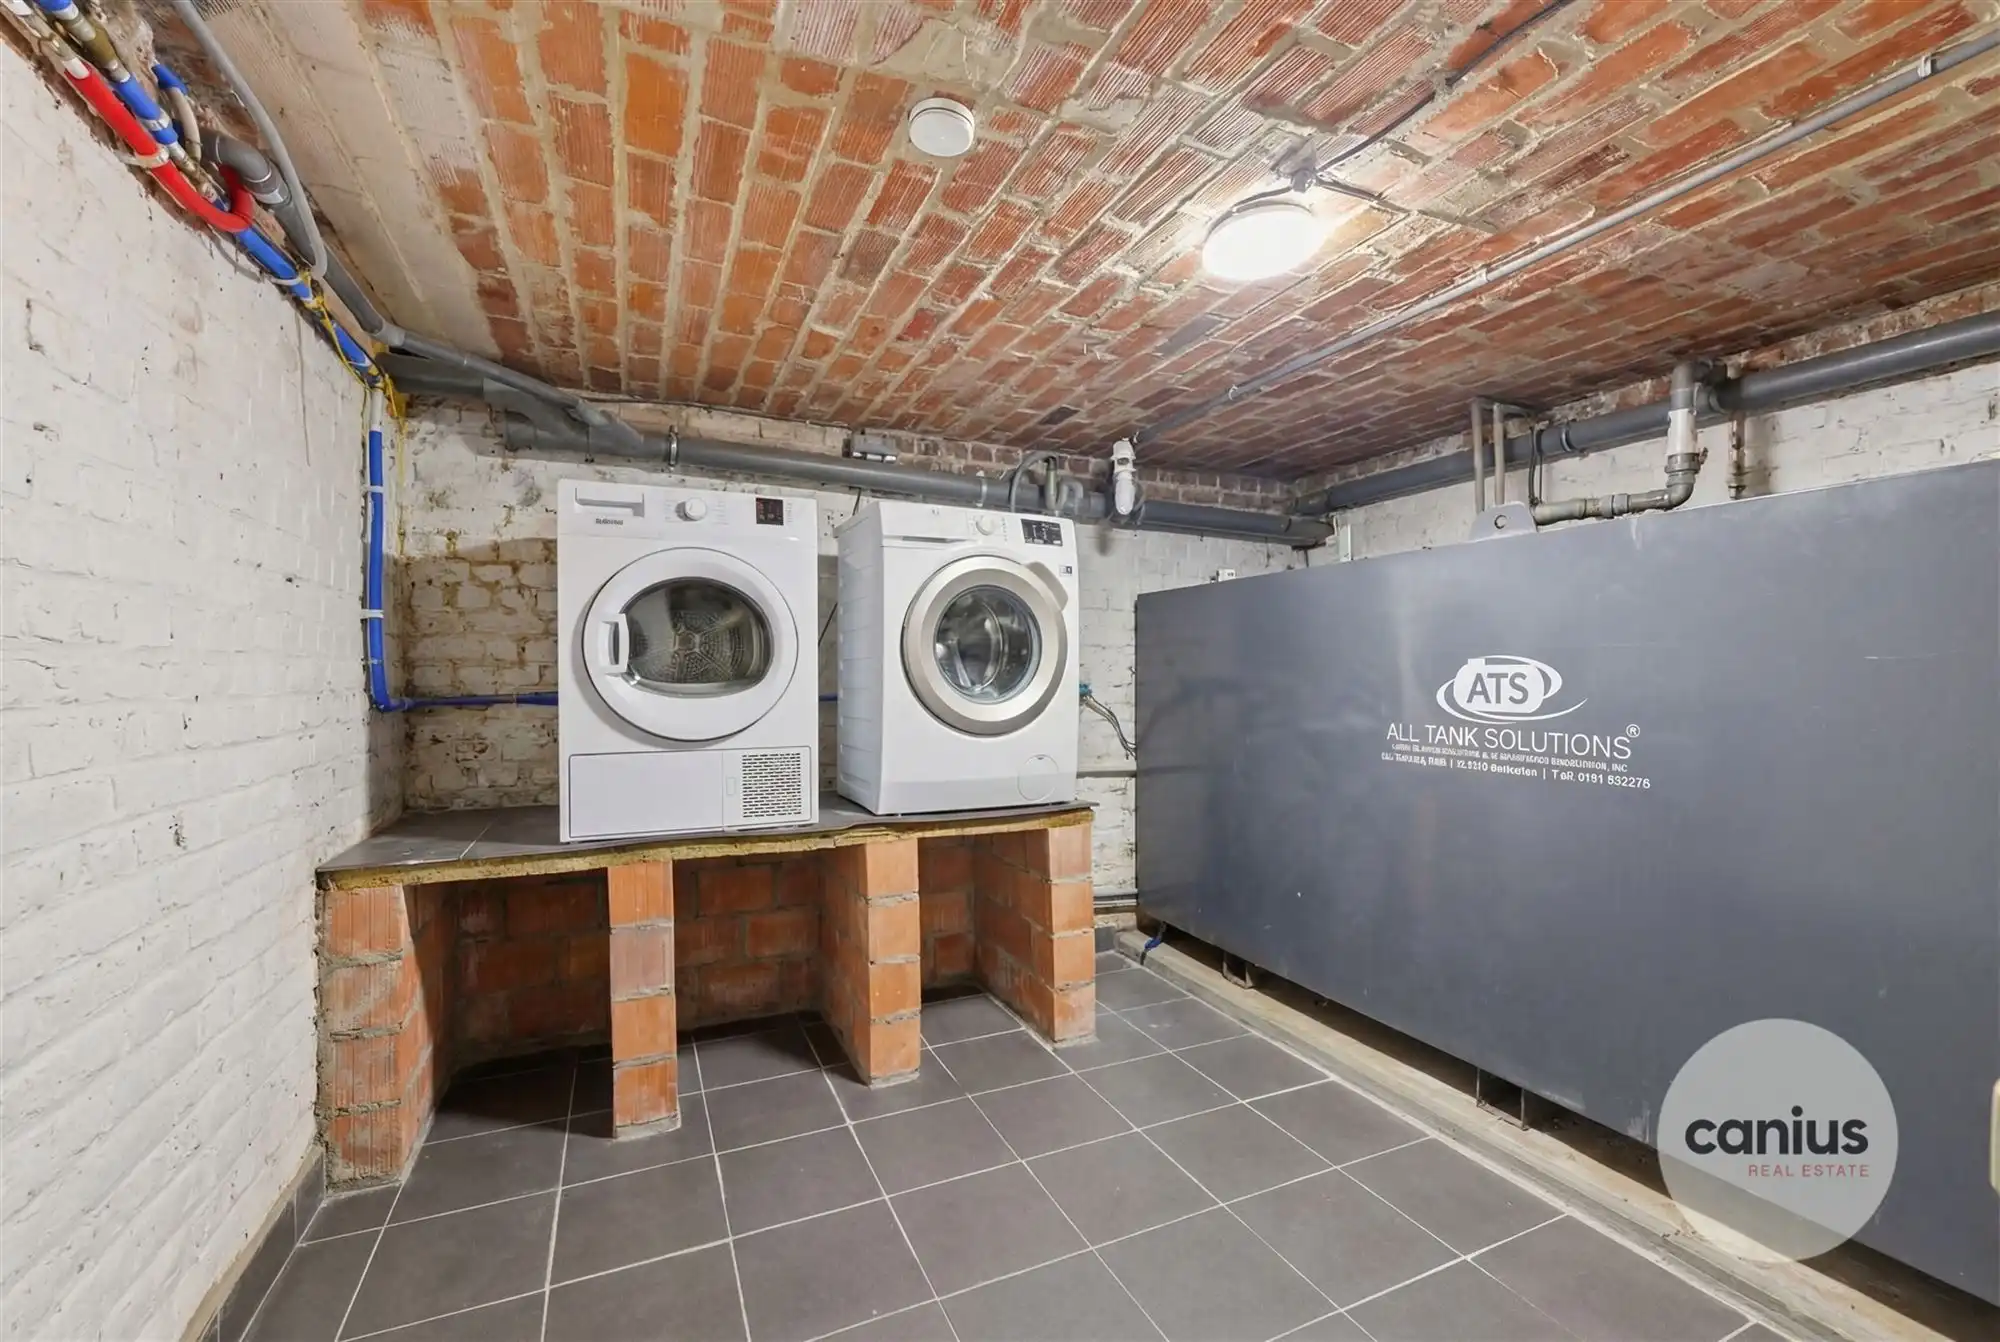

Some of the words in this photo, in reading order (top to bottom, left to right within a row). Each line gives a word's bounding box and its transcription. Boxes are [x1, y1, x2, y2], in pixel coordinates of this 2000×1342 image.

[1466, 671, 1529, 705] ATS
[1386, 722, 1420, 742] ALL
[1424, 724, 1479, 748] TANK
